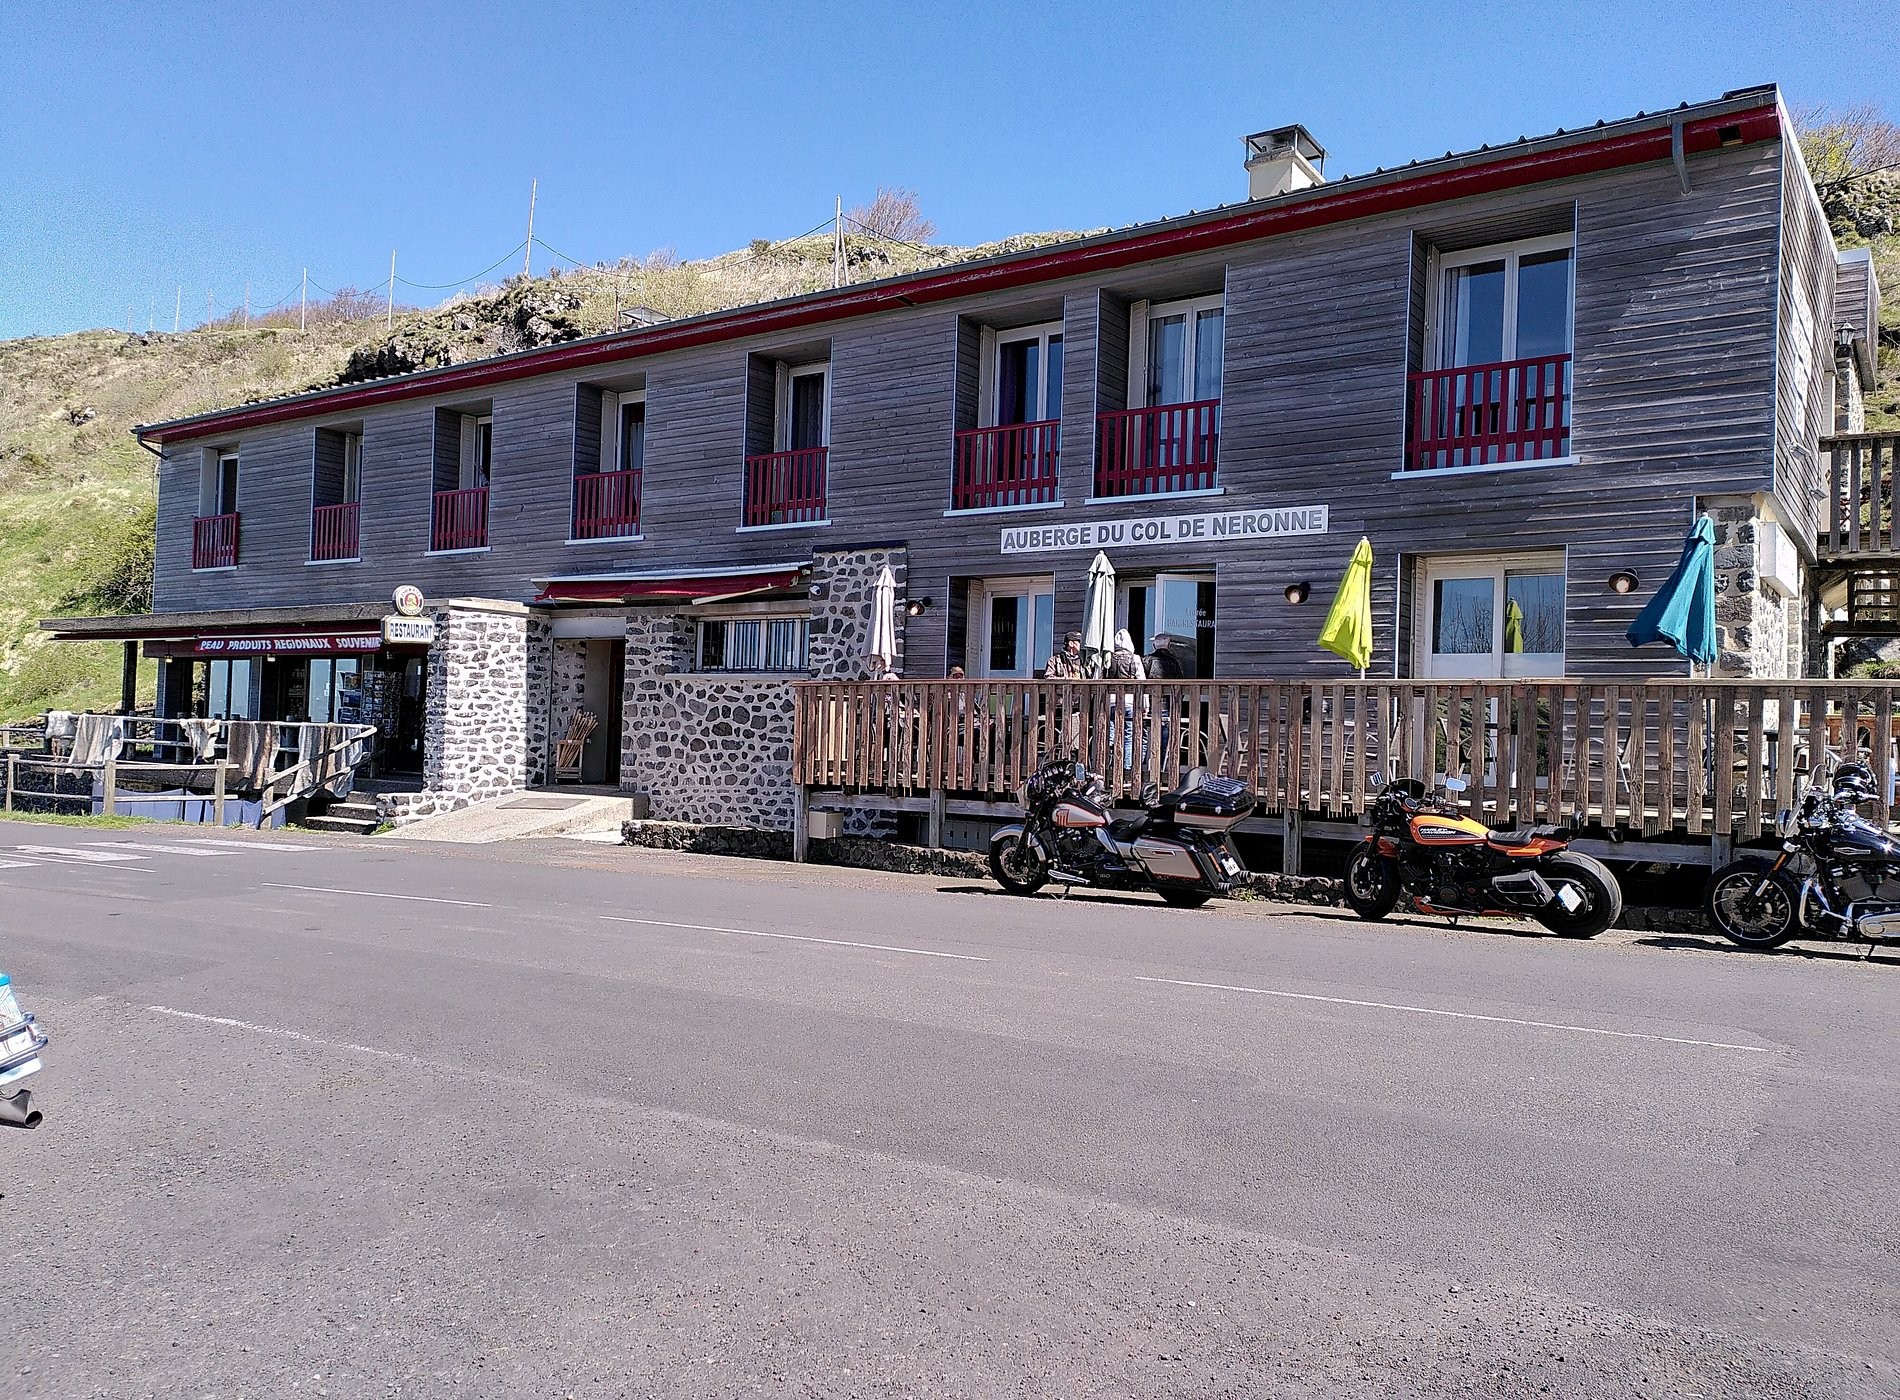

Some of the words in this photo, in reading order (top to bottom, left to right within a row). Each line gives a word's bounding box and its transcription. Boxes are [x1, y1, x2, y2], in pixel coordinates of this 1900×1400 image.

[1003, 527, 1091, 550] AUBERGE
[1098, 524, 1125, 543] DU
[1131, 520, 1171, 541] COL
[1178, 518, 1205, 538] DE
[1212, 509, 1323, 536] NERONNE
[389, 622, 433, 639] RESTAURANT
[200, 640, 225, 651] PEAU
[226, 639, 272, 650] PRODUITS
[273, 637, 332, 650] REGIONAUX
